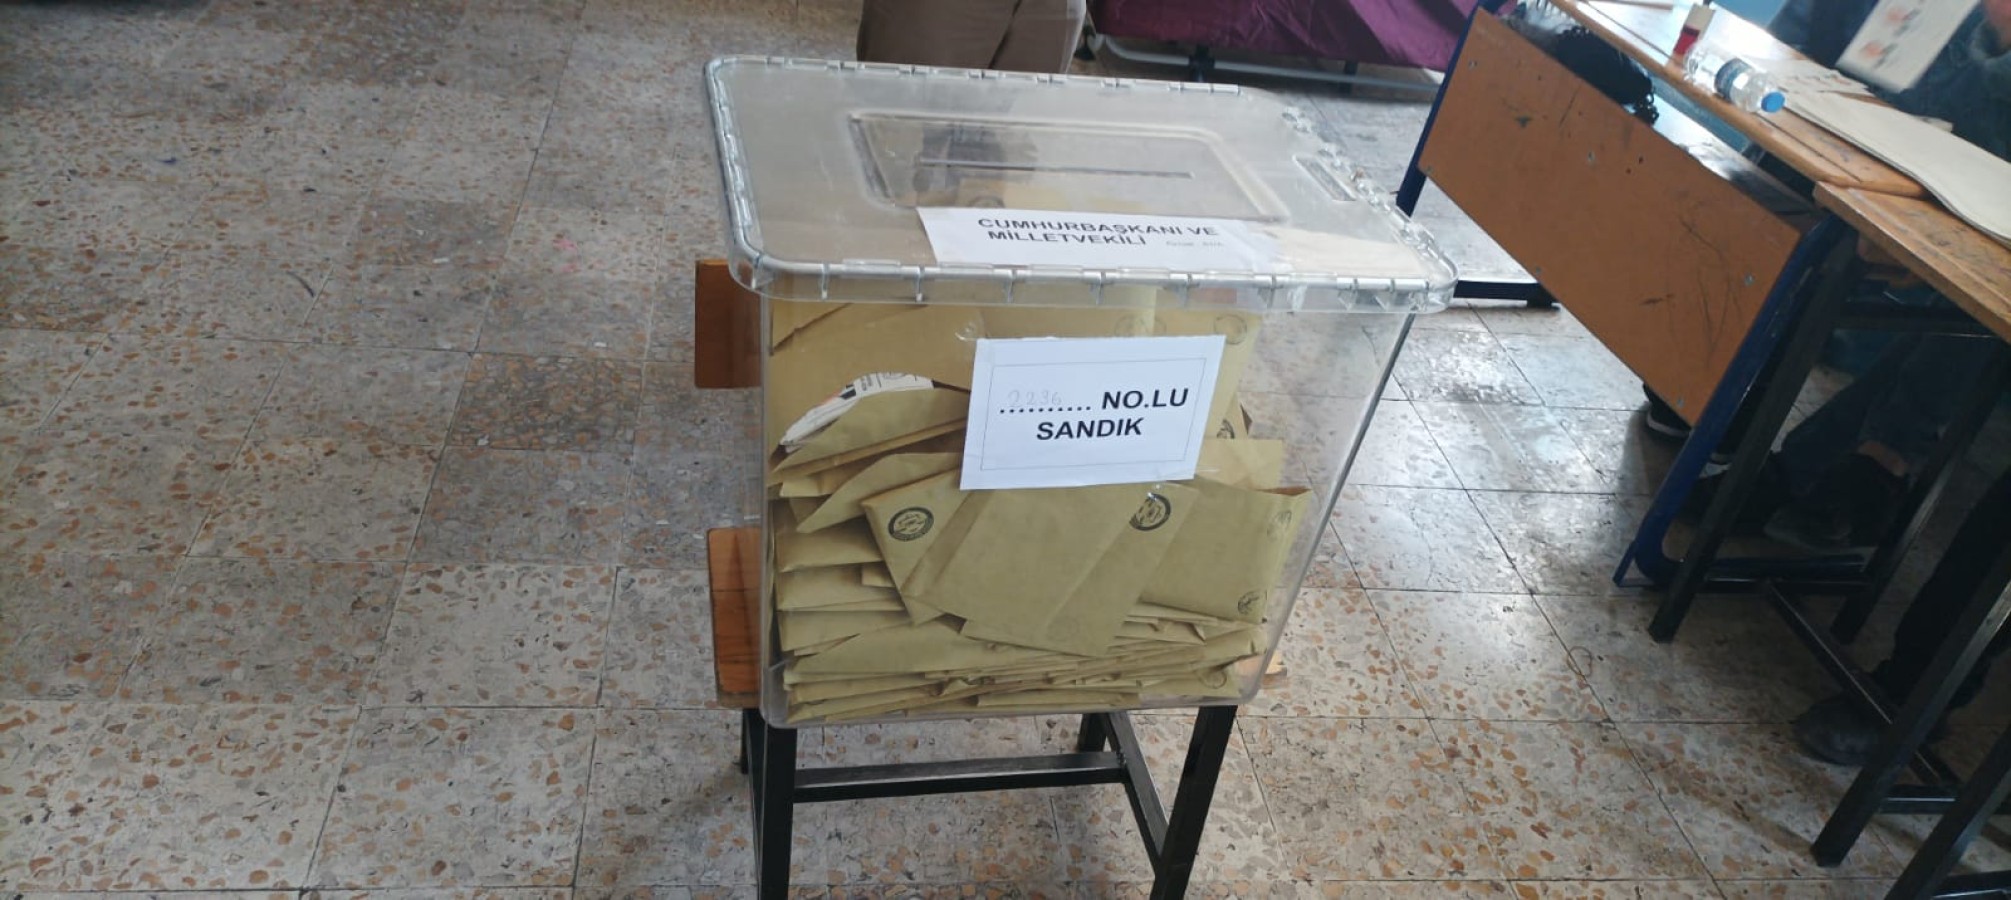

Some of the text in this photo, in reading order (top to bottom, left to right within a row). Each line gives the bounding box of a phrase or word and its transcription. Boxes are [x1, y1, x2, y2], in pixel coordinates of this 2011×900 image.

[978, 218, 1219, 236] CUMHURBAŞKANI VE
[988, 230, 1146, 245] MİLLETVEKİLİ
[1101, 388, 1189, 410] NO.LU
[1036, 417, 1144, 441] SANDIK
